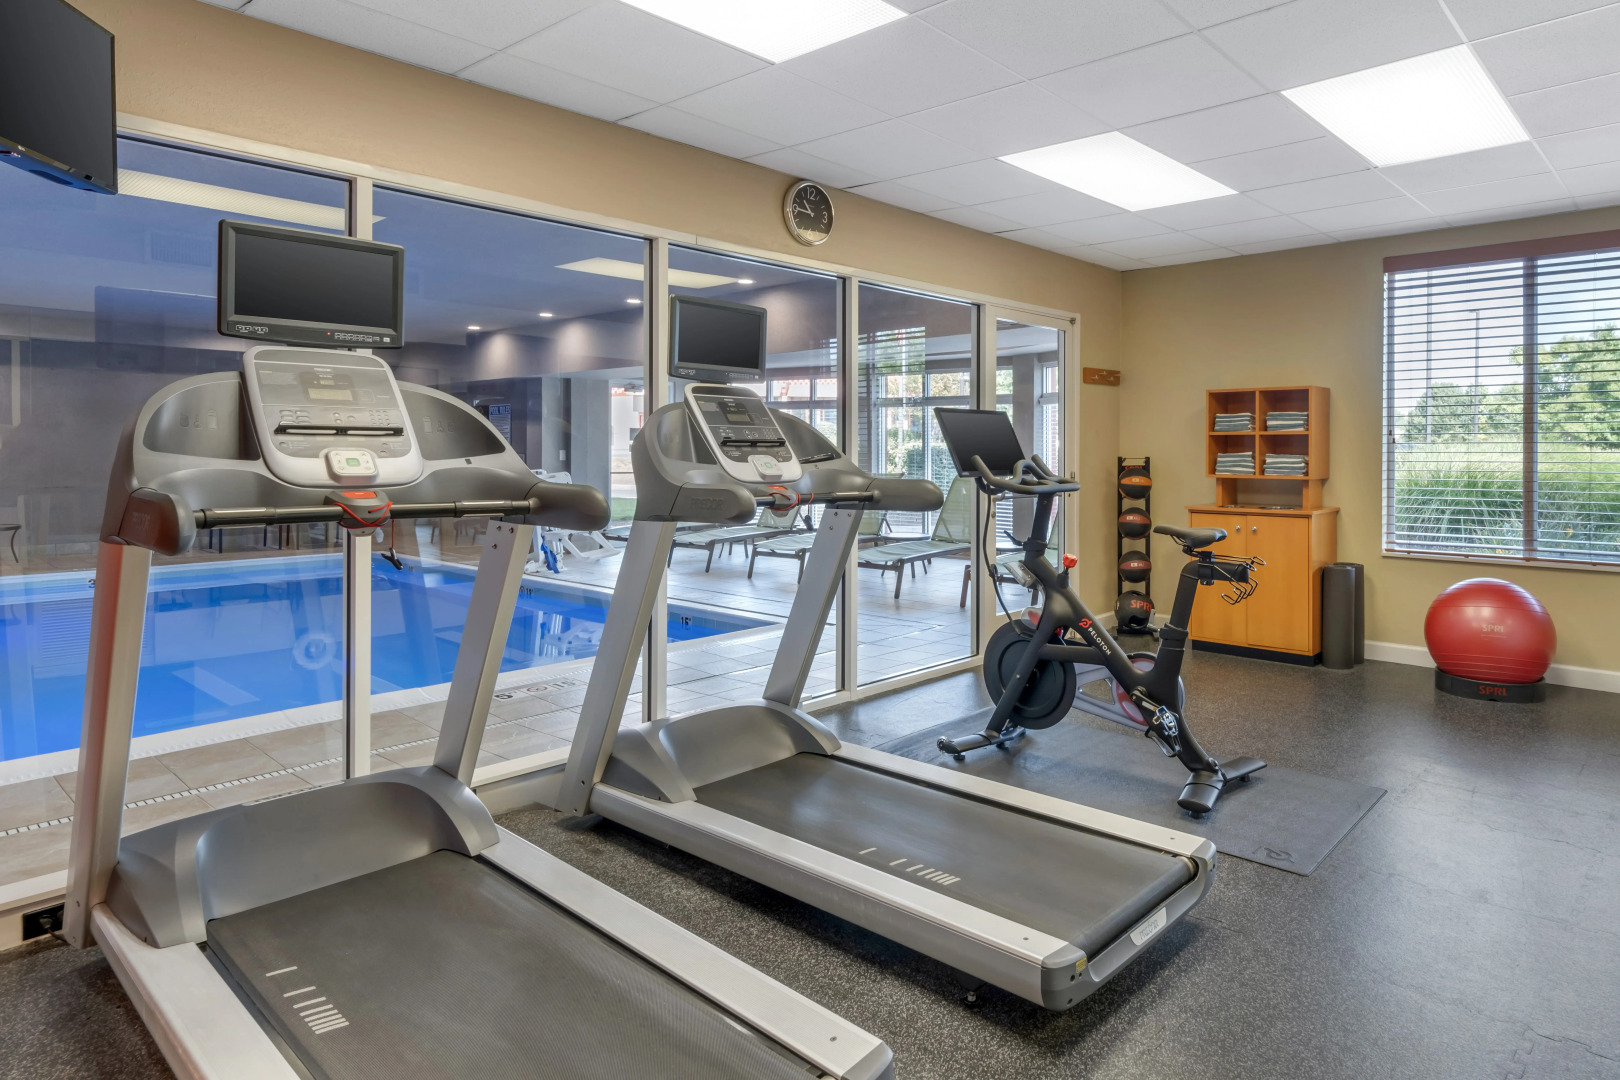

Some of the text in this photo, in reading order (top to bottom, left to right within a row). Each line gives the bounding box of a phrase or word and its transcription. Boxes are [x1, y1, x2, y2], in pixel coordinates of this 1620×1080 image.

[806, 186, 816, 200] 12
[792, 203, 799, 215] 9
[822, 211, 828, 223] 3
[806, 228, 813, 240] 6
[490, 406, 499, 415] POOL
[1130, 599, 1152, 612] SPRI
[1482, 624, 1505, 633] SPRI
[1087, 627, 1112, 656] PELOTON
[1479, 685, 1507, 697] SPRI
